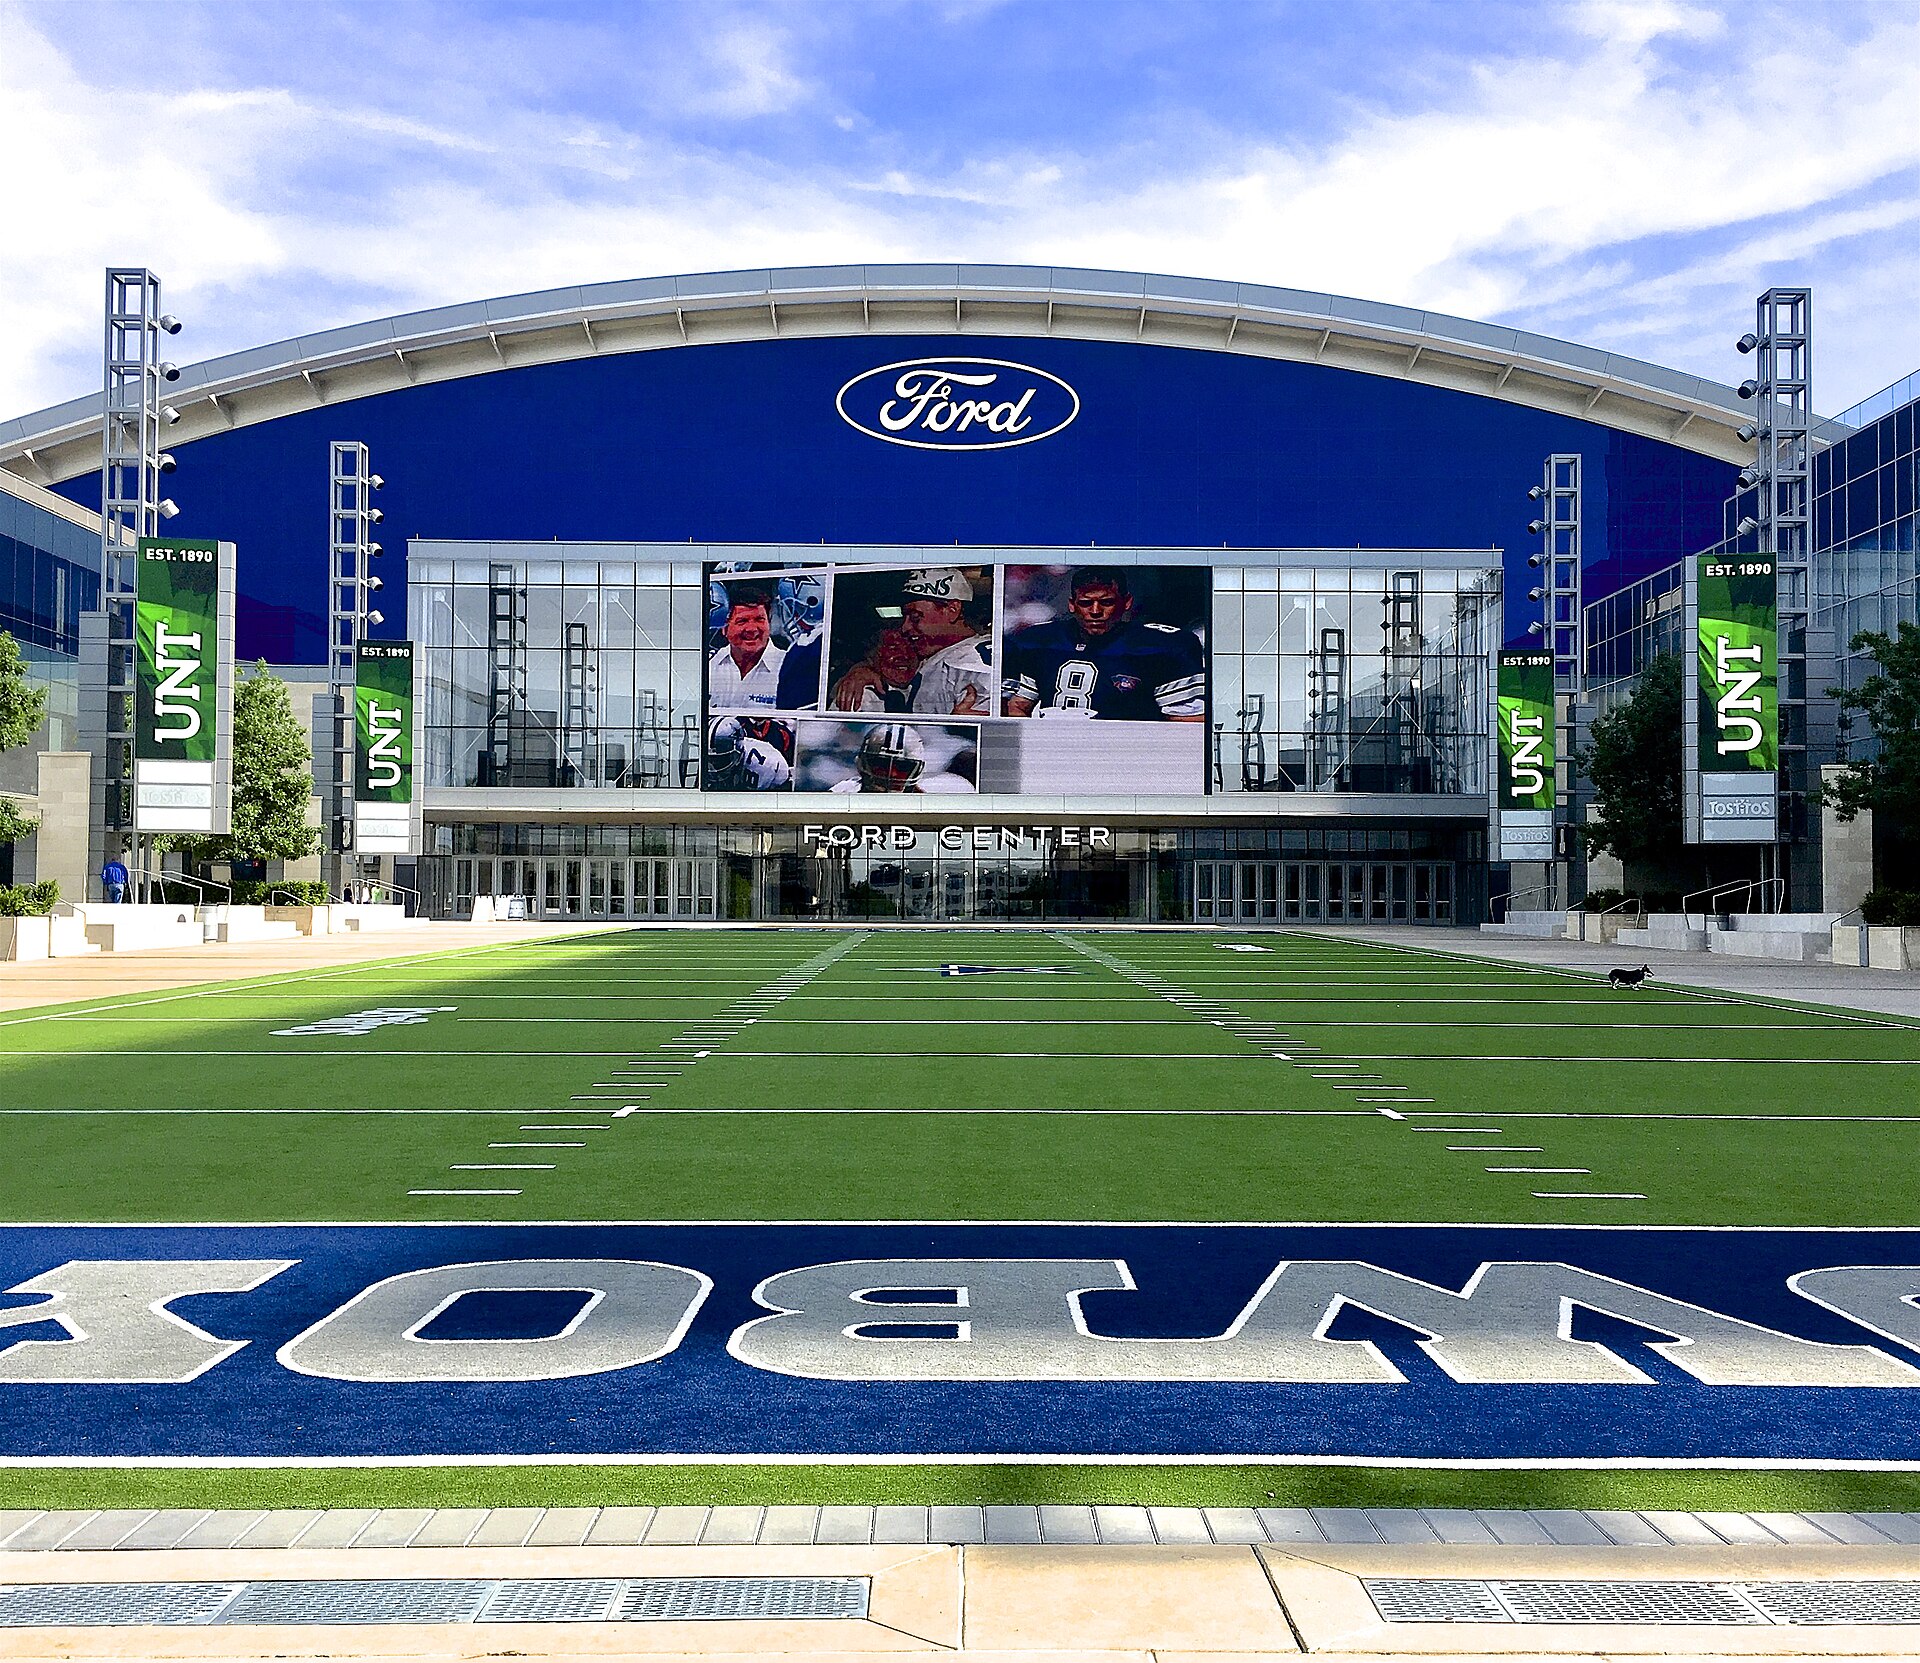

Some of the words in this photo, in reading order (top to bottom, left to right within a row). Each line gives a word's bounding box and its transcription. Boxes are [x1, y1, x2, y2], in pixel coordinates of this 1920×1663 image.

[878, 369, 1038, 433] Ford
[145, 548, 177, 563] EST.
[179, 549, 214, 564] 1890
[1706, 564, 1736, 577] EST.
[1738, 562, 1772, 576] 1890
[361, 646, 385, 658] EST.
[386, 646, 411, 659] 1890
[1503, 656, 1527, 666] EST.
[1527, 655, 1551, 666] 1890
[154, 621, 202, 744] UNT
[1053, 659, 1099, 708] 8
[1717, 634, 1764, 756] UNT
[368, 700, 402, 791] UNT
[1512, 709, 1545, 798] UNT
[802, 824, 916, 847] FORD
[938, 825, 1111, 847] CENTER
